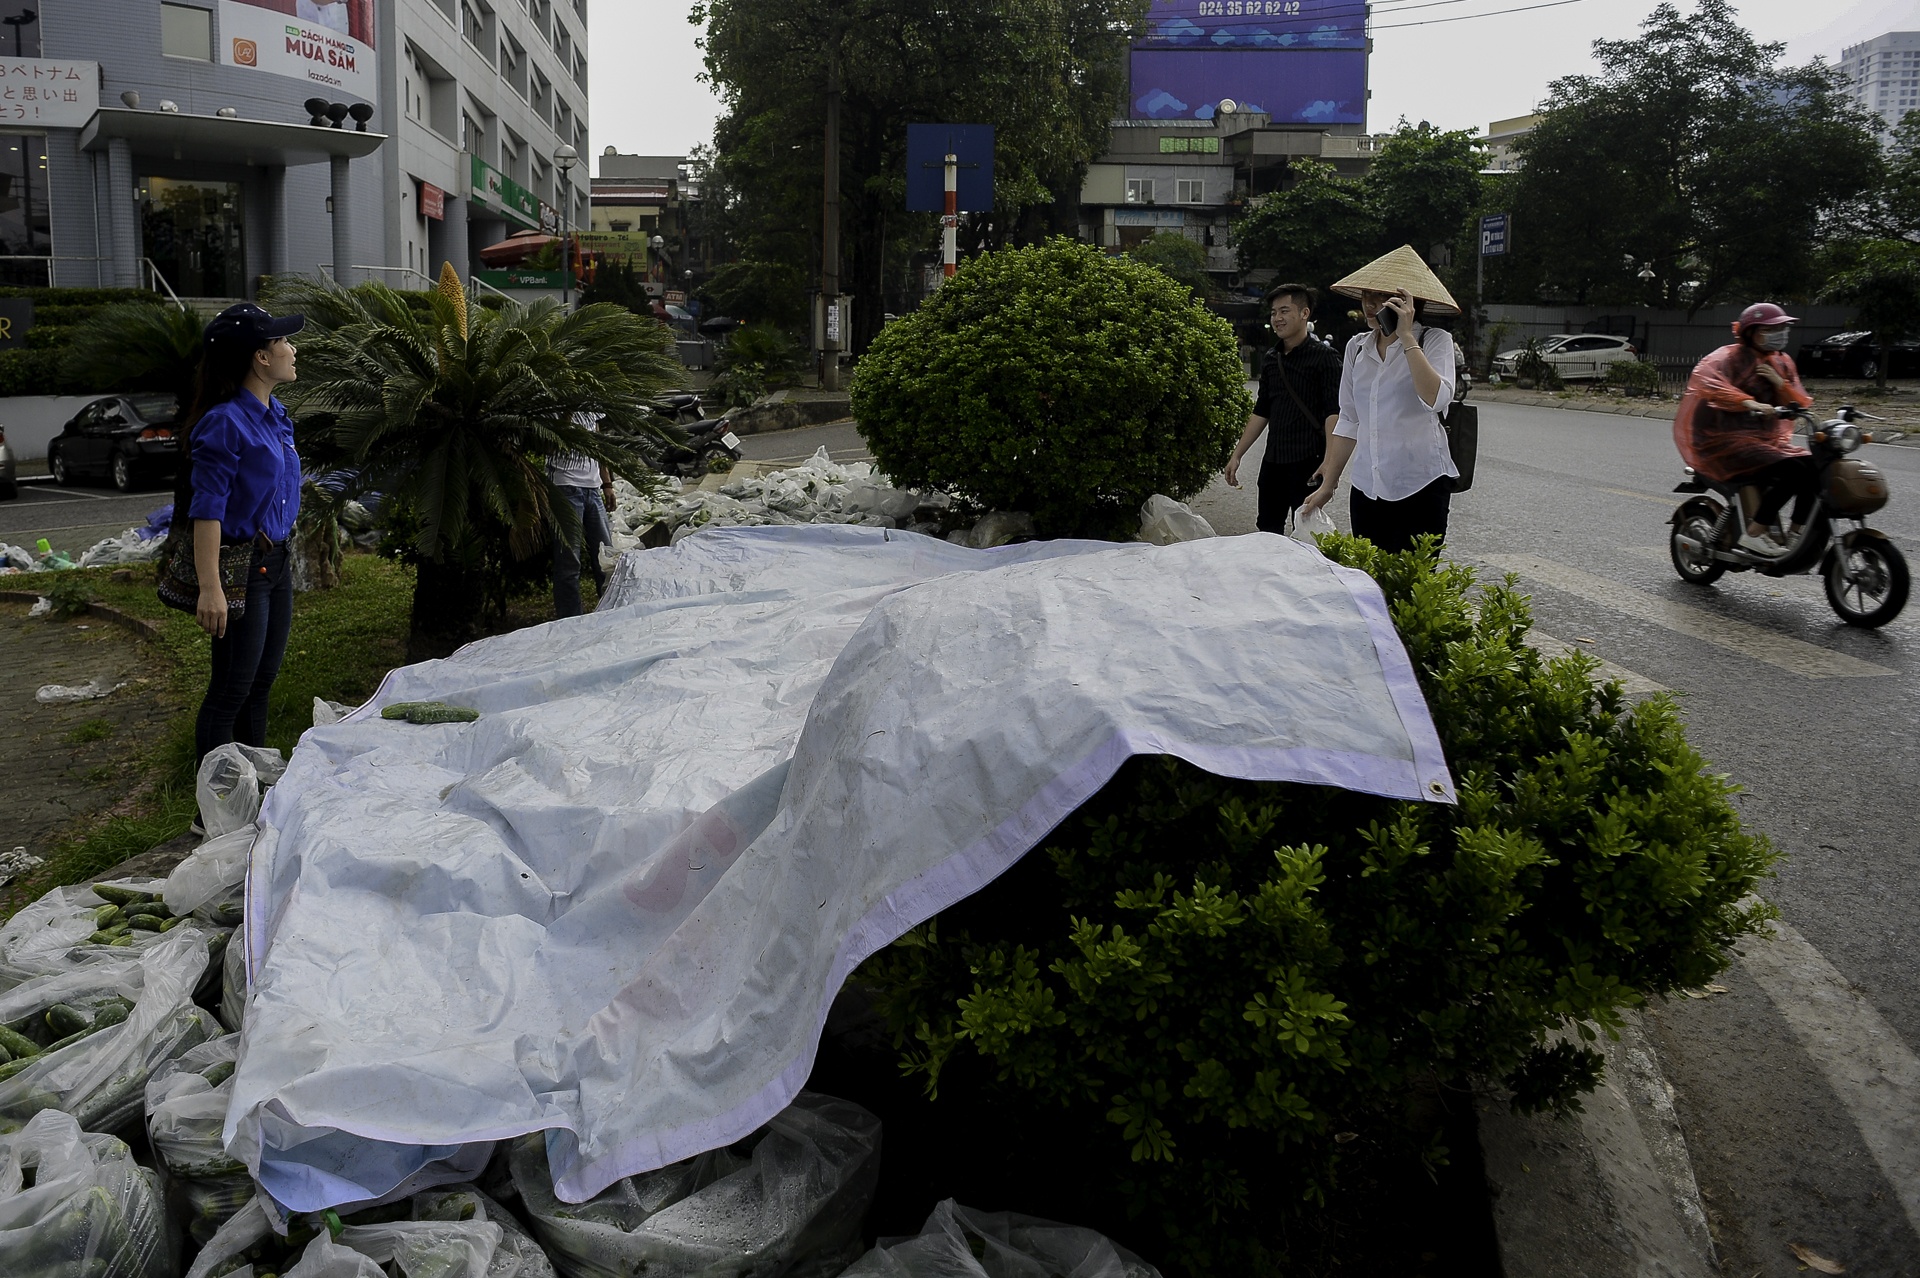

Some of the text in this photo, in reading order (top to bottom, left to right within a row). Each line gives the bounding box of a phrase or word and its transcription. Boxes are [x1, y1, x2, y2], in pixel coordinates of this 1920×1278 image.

[1199, 1, 1299, 15] 024 35 62 62 42
[285, 36, 325, 64] MUA
[307, 69, 342, 87] lazada.vn
[3, 85, 77, 102] と思い出
[666, 293, 683, 301] ATM
